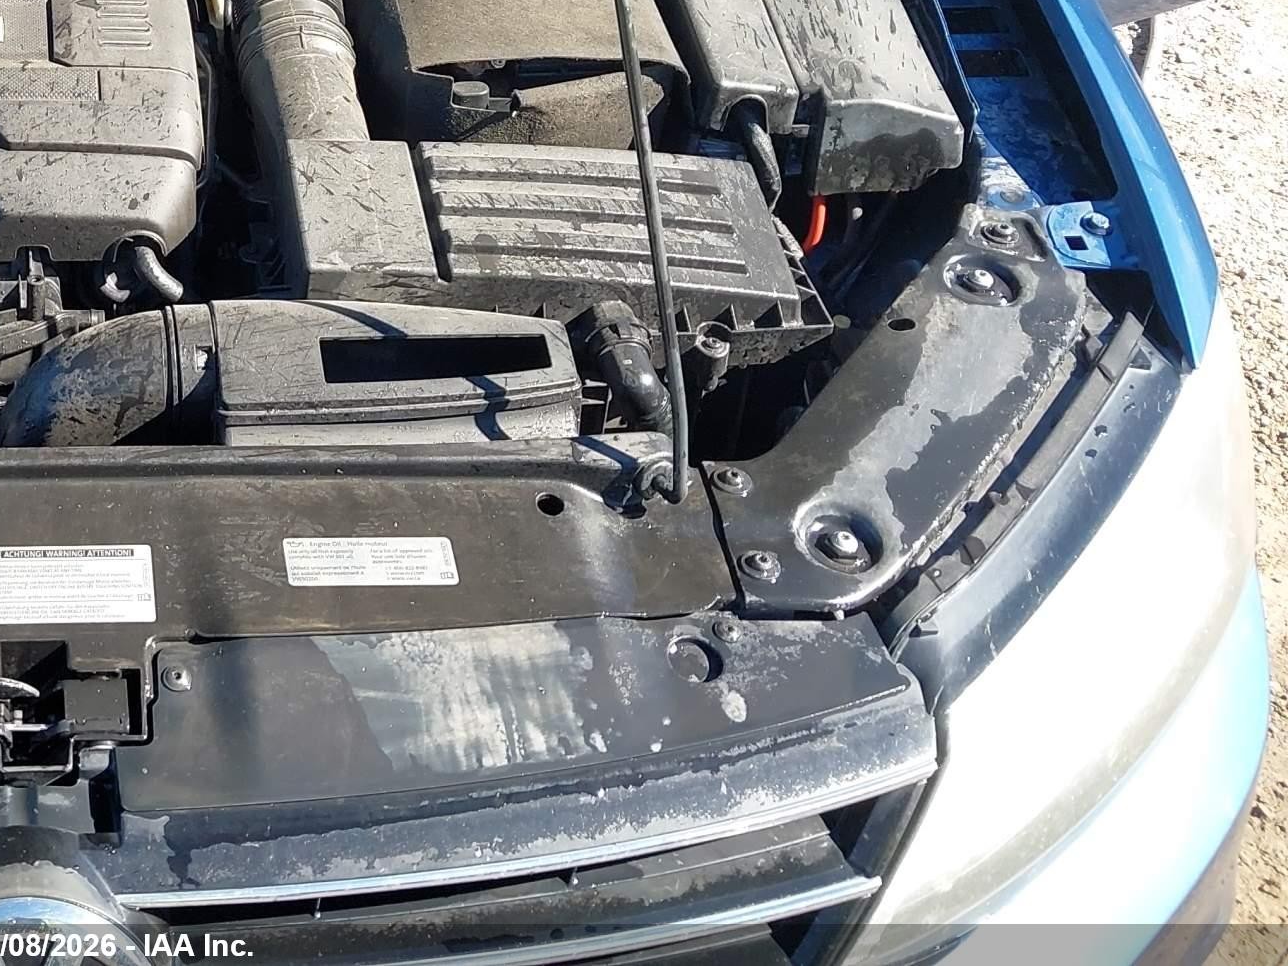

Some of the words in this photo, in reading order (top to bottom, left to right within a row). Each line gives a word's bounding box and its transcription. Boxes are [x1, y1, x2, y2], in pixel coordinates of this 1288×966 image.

[3, 550, 44, 558] ACHTUNG!
[45, 549, 85, 558] WARNING!
[86, 548, 132, 557] ATTENTION!
